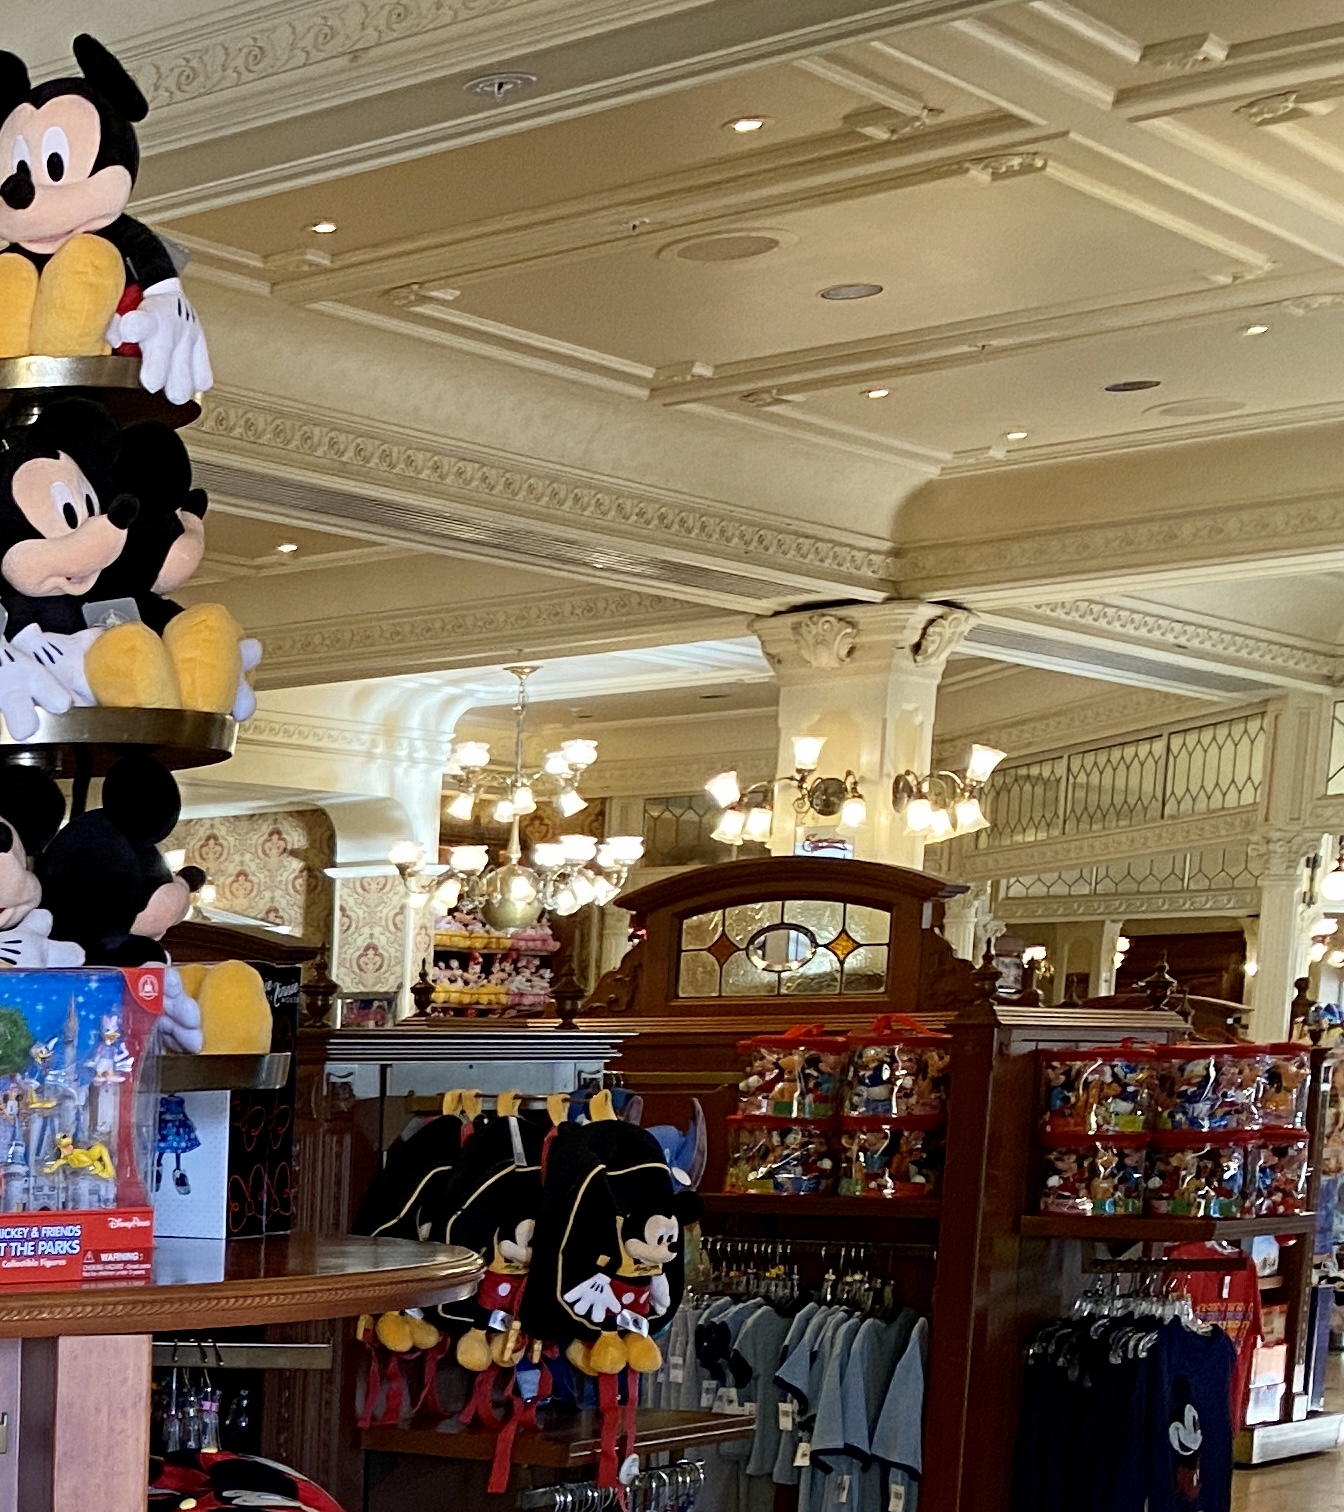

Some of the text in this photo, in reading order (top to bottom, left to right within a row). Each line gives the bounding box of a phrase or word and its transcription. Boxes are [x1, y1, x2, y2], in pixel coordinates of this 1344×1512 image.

[31, 1227, 39, 1238] &
[41, 1225, 81, 1238] FRIENDS
[9, 1242, 34, 1256] THE
[38, 1240, 80, 1255] PARKS
